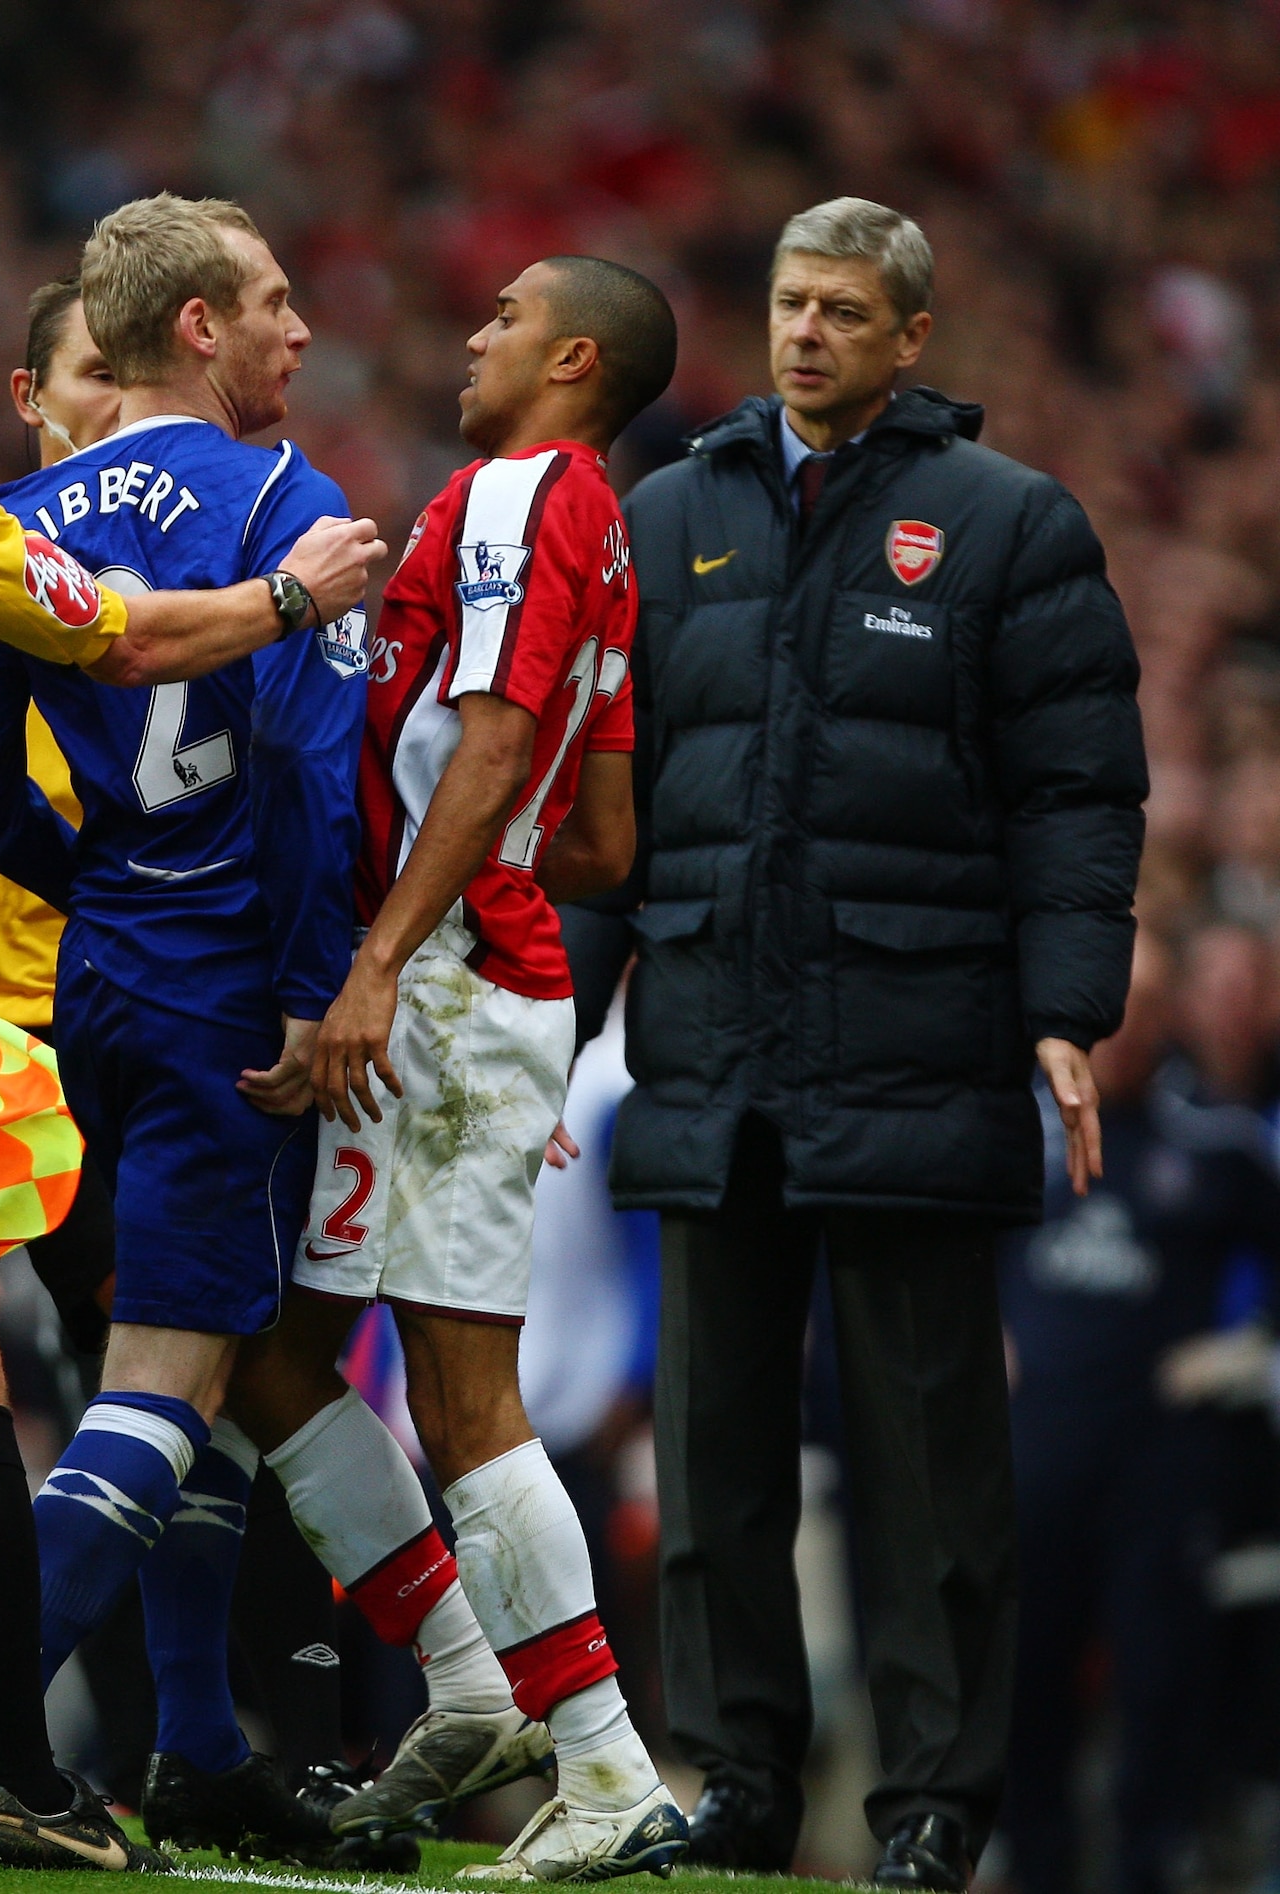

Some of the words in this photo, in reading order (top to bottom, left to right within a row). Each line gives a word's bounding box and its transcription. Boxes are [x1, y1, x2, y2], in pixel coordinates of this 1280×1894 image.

[467, 582, 504, 595] BARCLAYS
[889, 605, 913, 622] Fly
[863, 612, 934, 639] Emirates
[321, 1146, 377, 1245] 2
